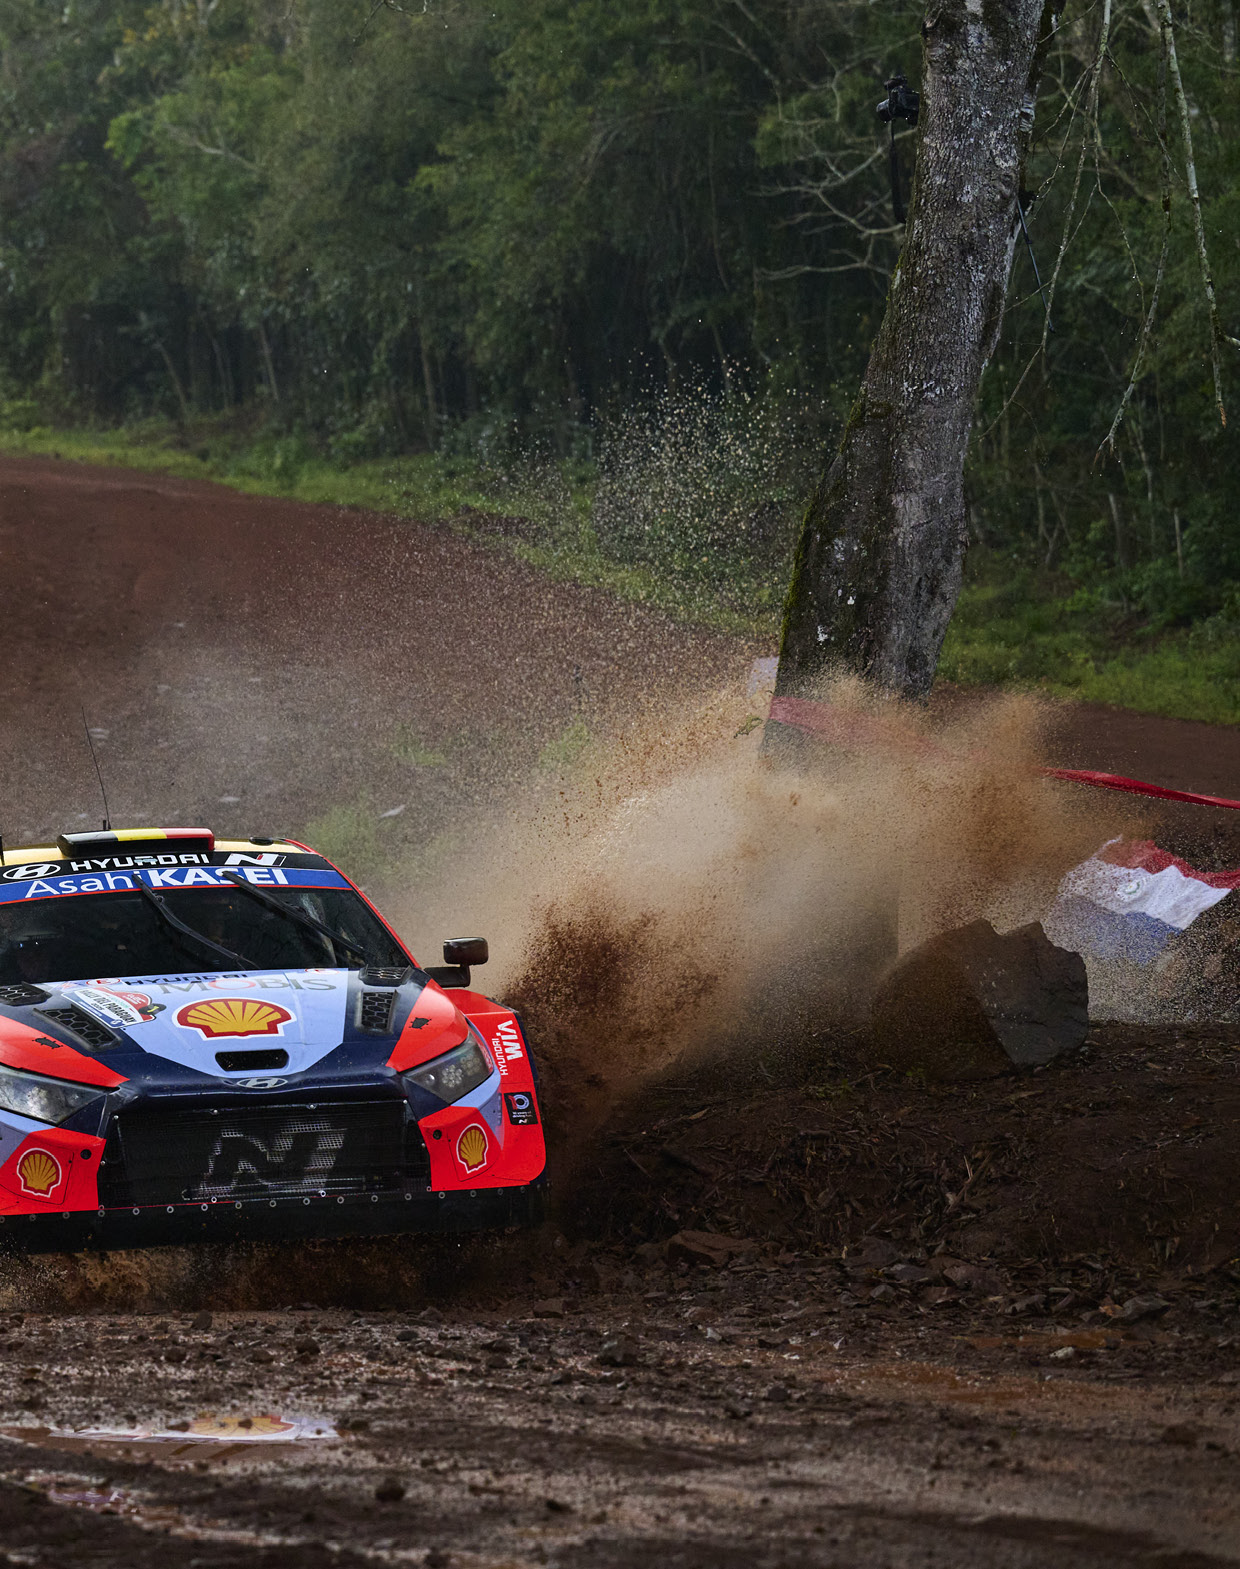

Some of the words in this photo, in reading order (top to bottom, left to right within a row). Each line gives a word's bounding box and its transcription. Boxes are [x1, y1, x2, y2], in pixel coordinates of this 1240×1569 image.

[70, 853, 210, 871] HYUNDAI
[147, 868, 288, 887] KASEI
[124, 973, 248, 986] HYUNDAI
[160, 978, 337, 994] MOBIS
[491, 1037, 509, 1076] HYUNDAI
